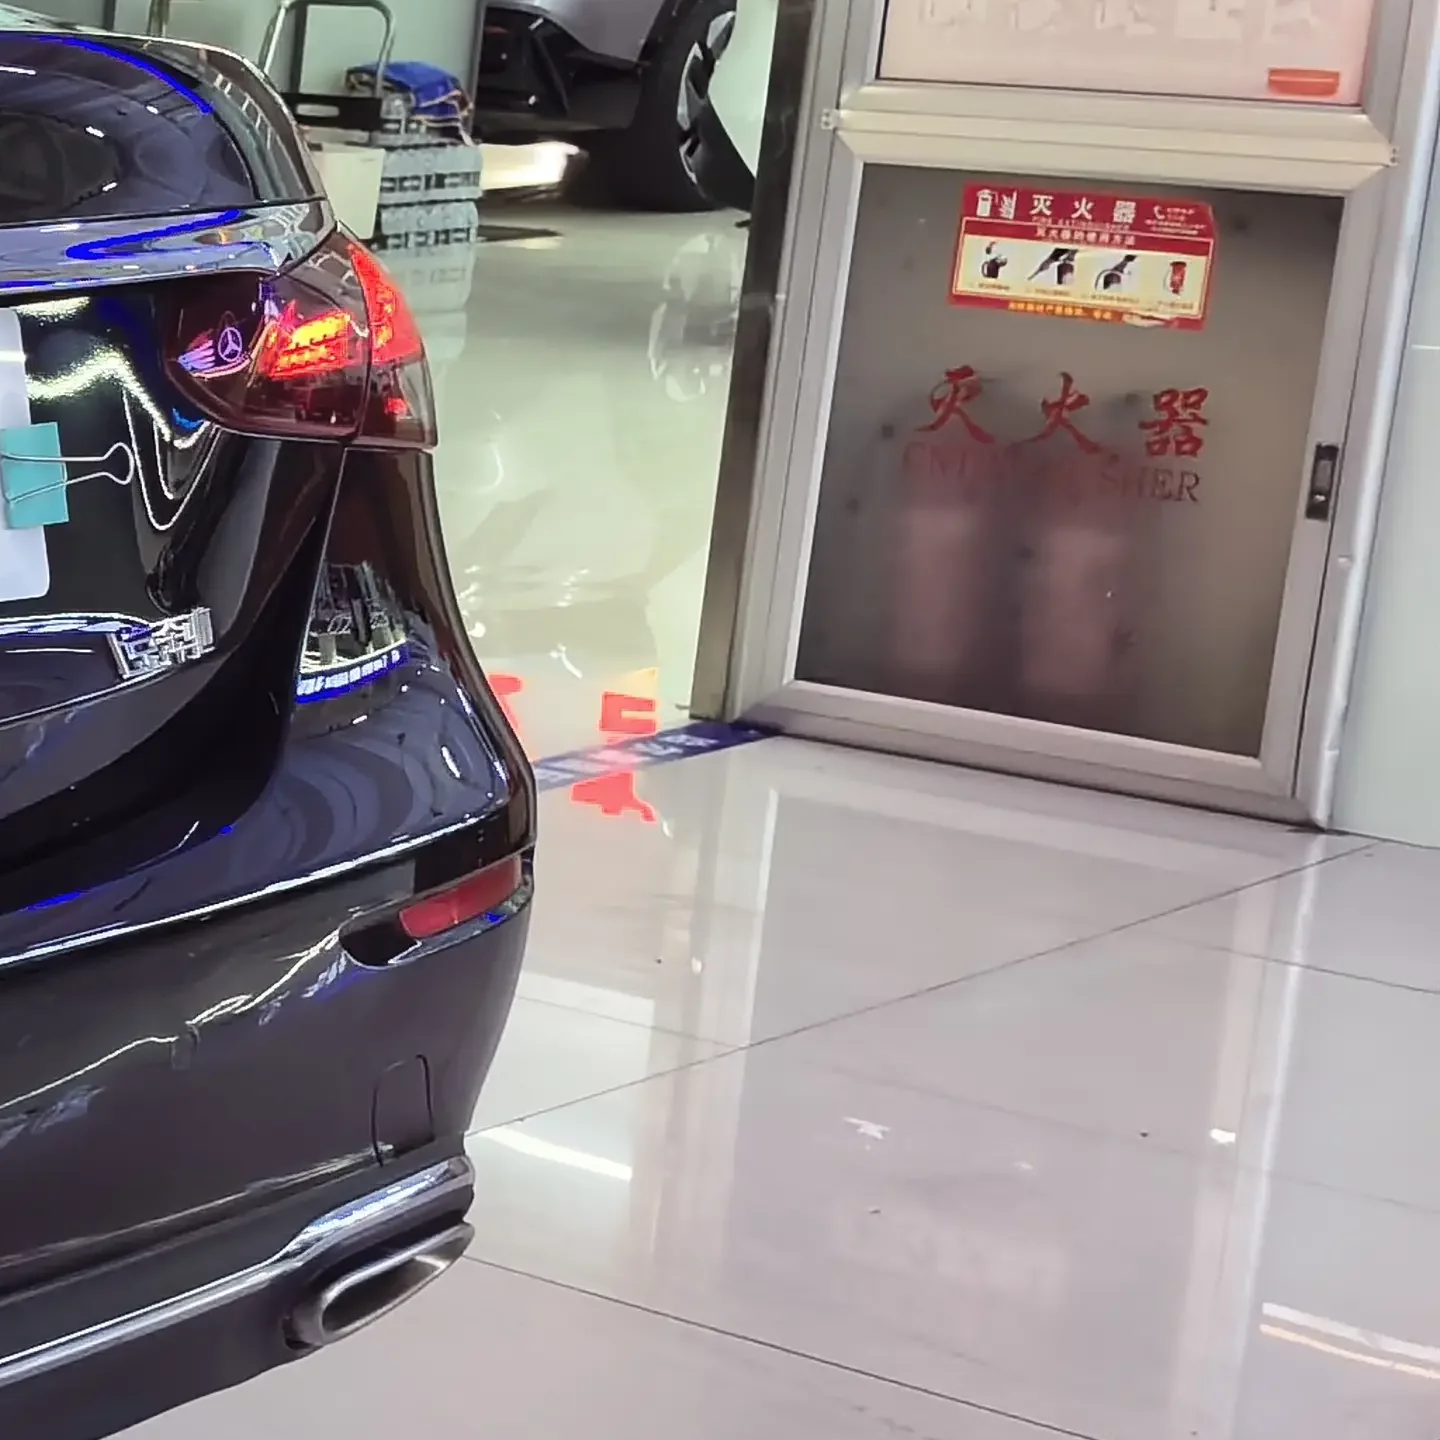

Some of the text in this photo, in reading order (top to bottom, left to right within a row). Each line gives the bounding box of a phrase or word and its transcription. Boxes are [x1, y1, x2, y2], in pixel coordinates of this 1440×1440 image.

[1029, 193, 1137, 224] 灭火器
[916, 364, 1210, 459] 灭火器
